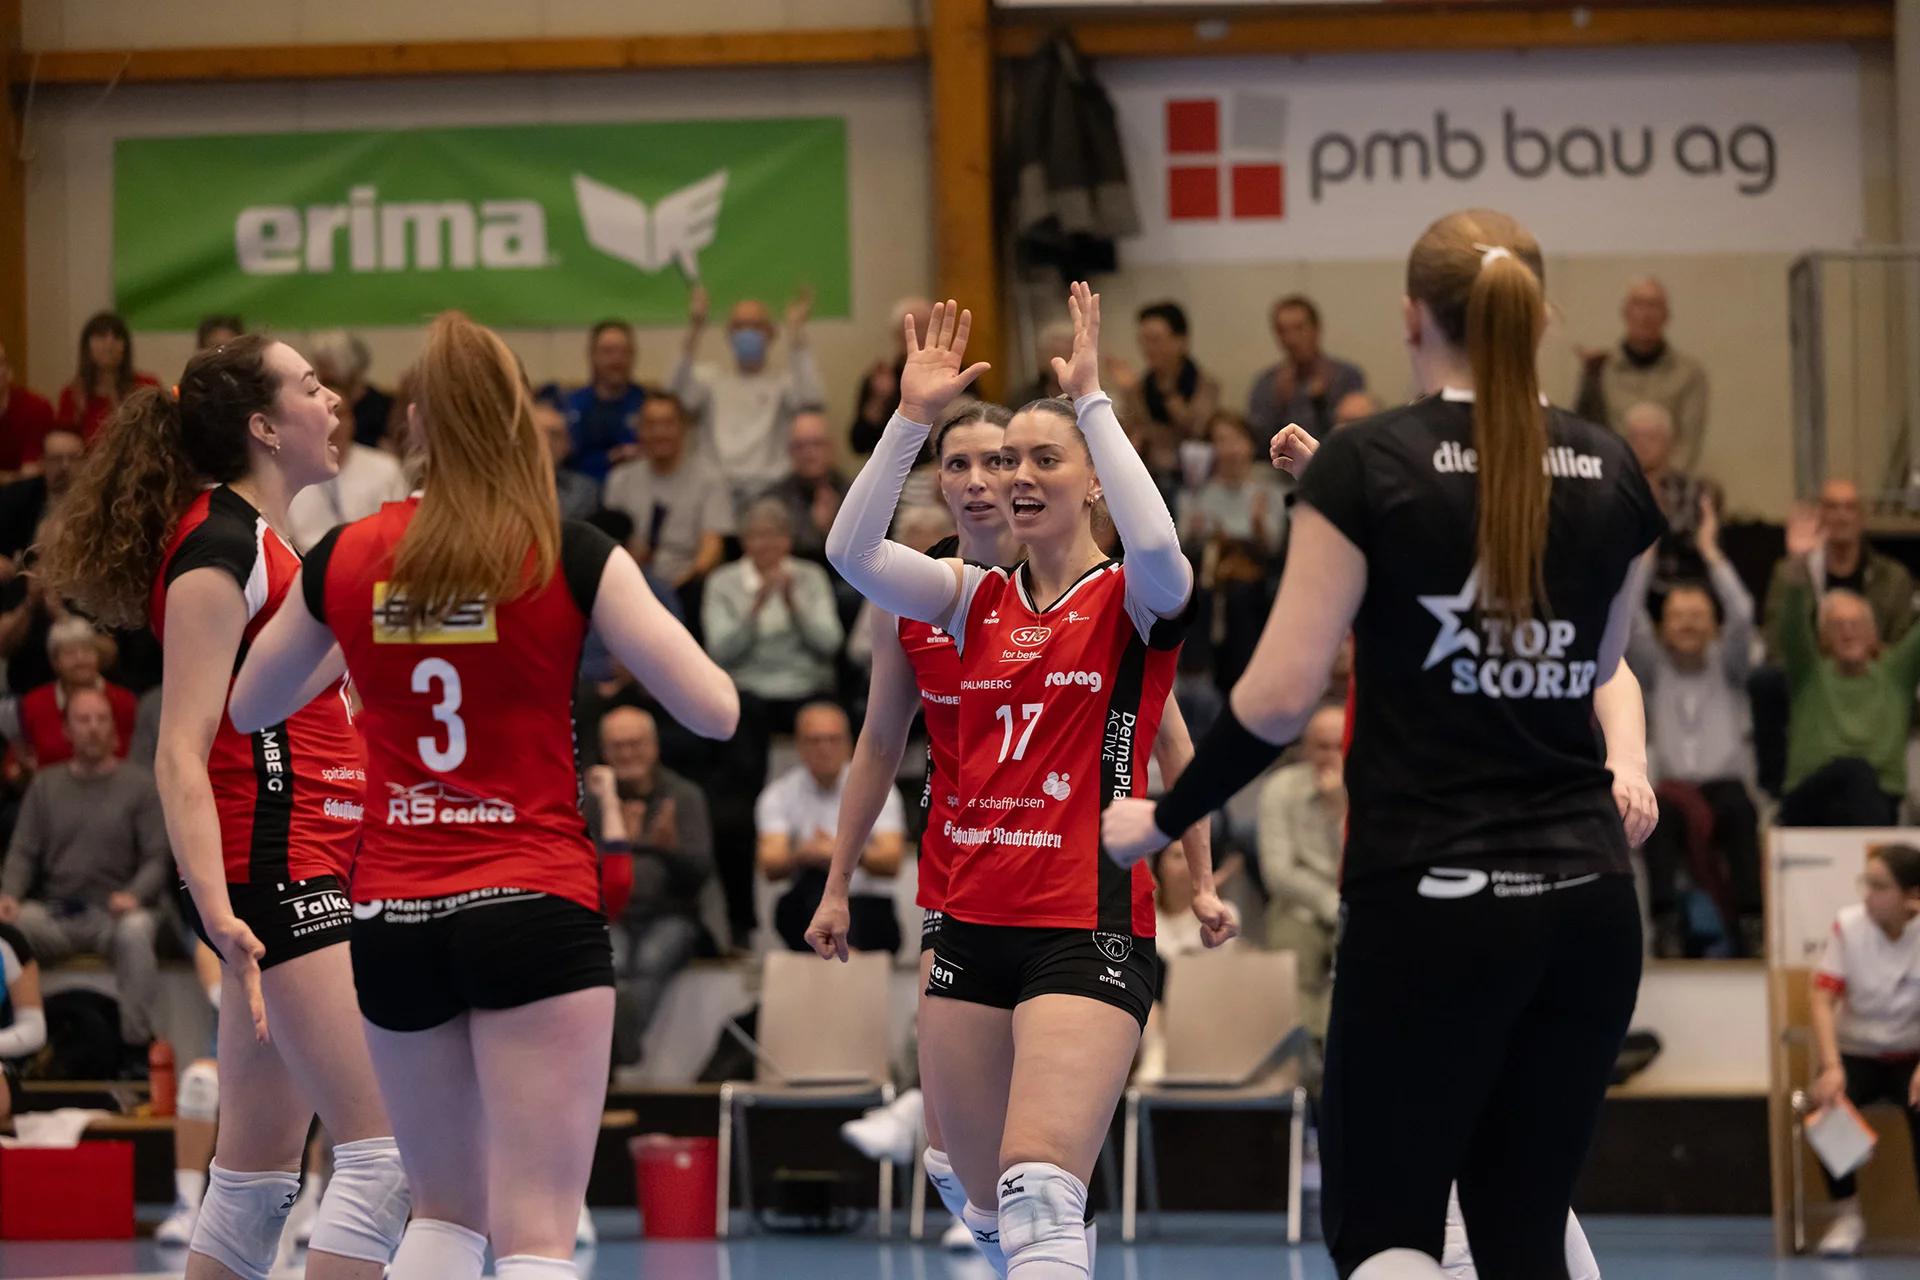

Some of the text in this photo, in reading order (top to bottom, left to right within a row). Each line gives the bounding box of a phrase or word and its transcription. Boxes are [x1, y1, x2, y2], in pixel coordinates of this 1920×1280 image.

[1310, 107, 1777, 203] pmb bau ag
[235, 185, 548, 274] erima
[926, 636, 949, 644] erima
[1002, 650, 1015, 659] for
[1481, 617, 1576, 659] TOP
[963, 679, 1012, 690] PALMBERG
[1044, 671, 1102, 693] sasag
[411, 657, 467, 772] 3
[995, 702, 1044, 764] 17
[1102, 708, 1121, 762] ACTIVE
[1113, 711, 1136, 801] DermaPla
[386, 796, 436, 825] RS
[1099, 974, 1126, 989] erima
